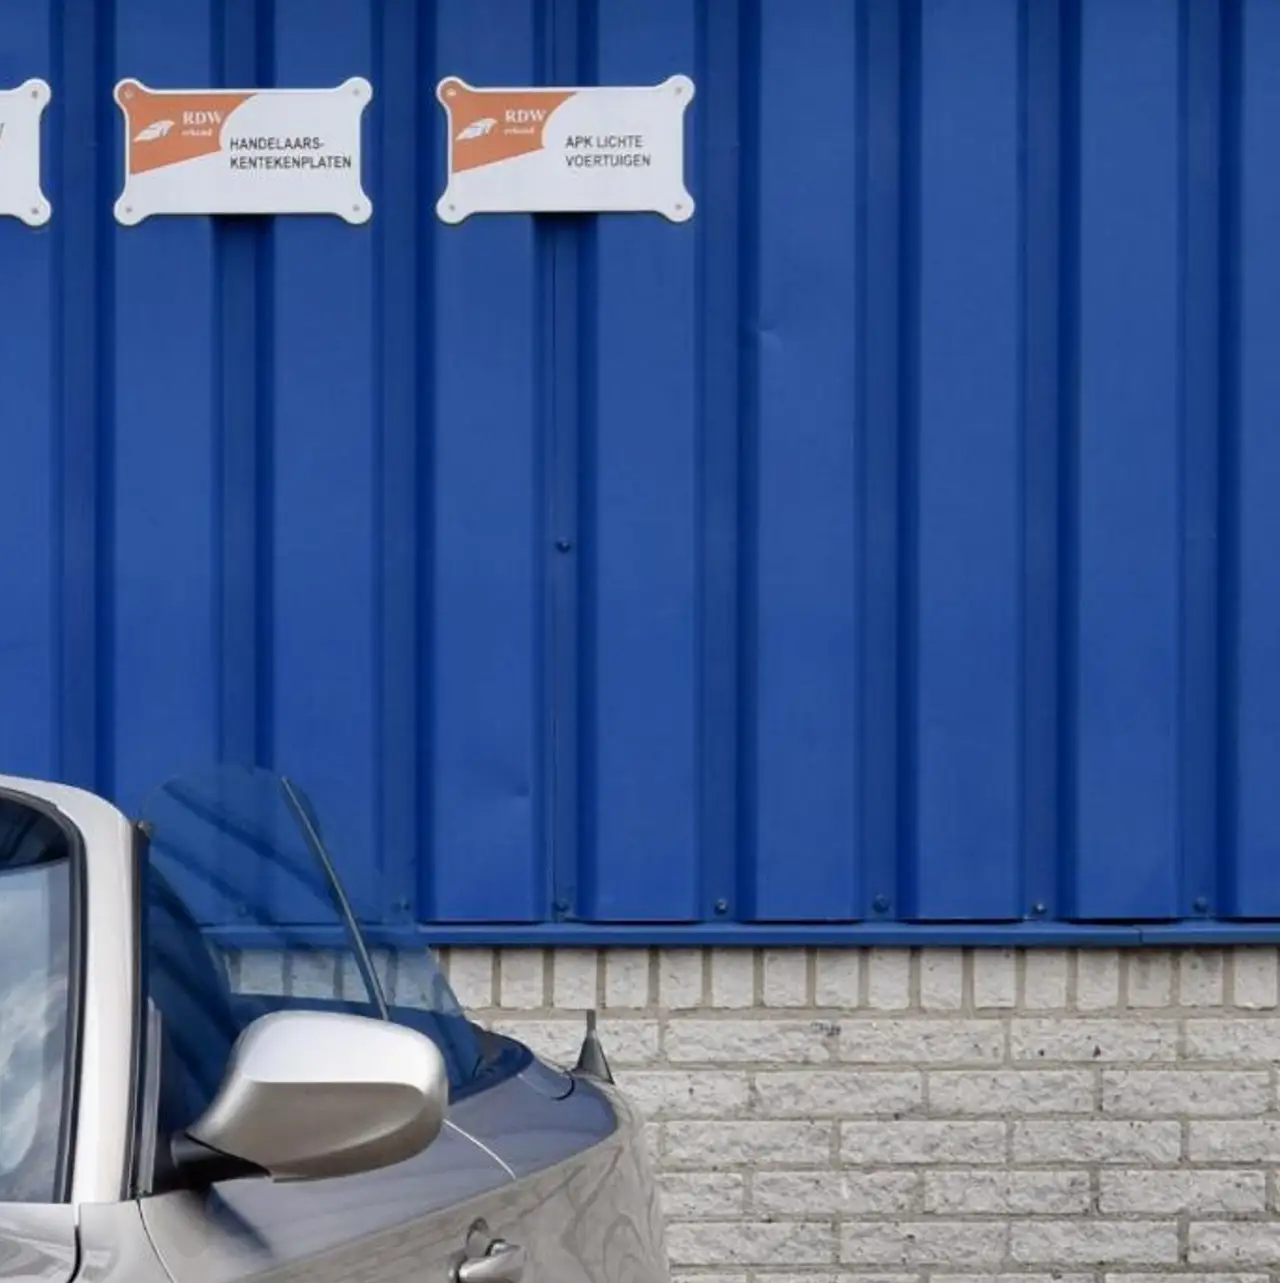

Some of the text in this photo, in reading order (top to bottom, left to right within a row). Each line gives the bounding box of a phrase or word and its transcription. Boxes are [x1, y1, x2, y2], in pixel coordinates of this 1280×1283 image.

[182, 110, 223, 125] RDW
[505, 109, 546, 123] RDW
[229, 137, 325, 150] HANDELAARS-
[565, 135, 644, 148] APK LICHTE
[229, 156, 351, 169] KENTEKENPLATEN
[565, 154, 652, 167] VOERTUIGEN
